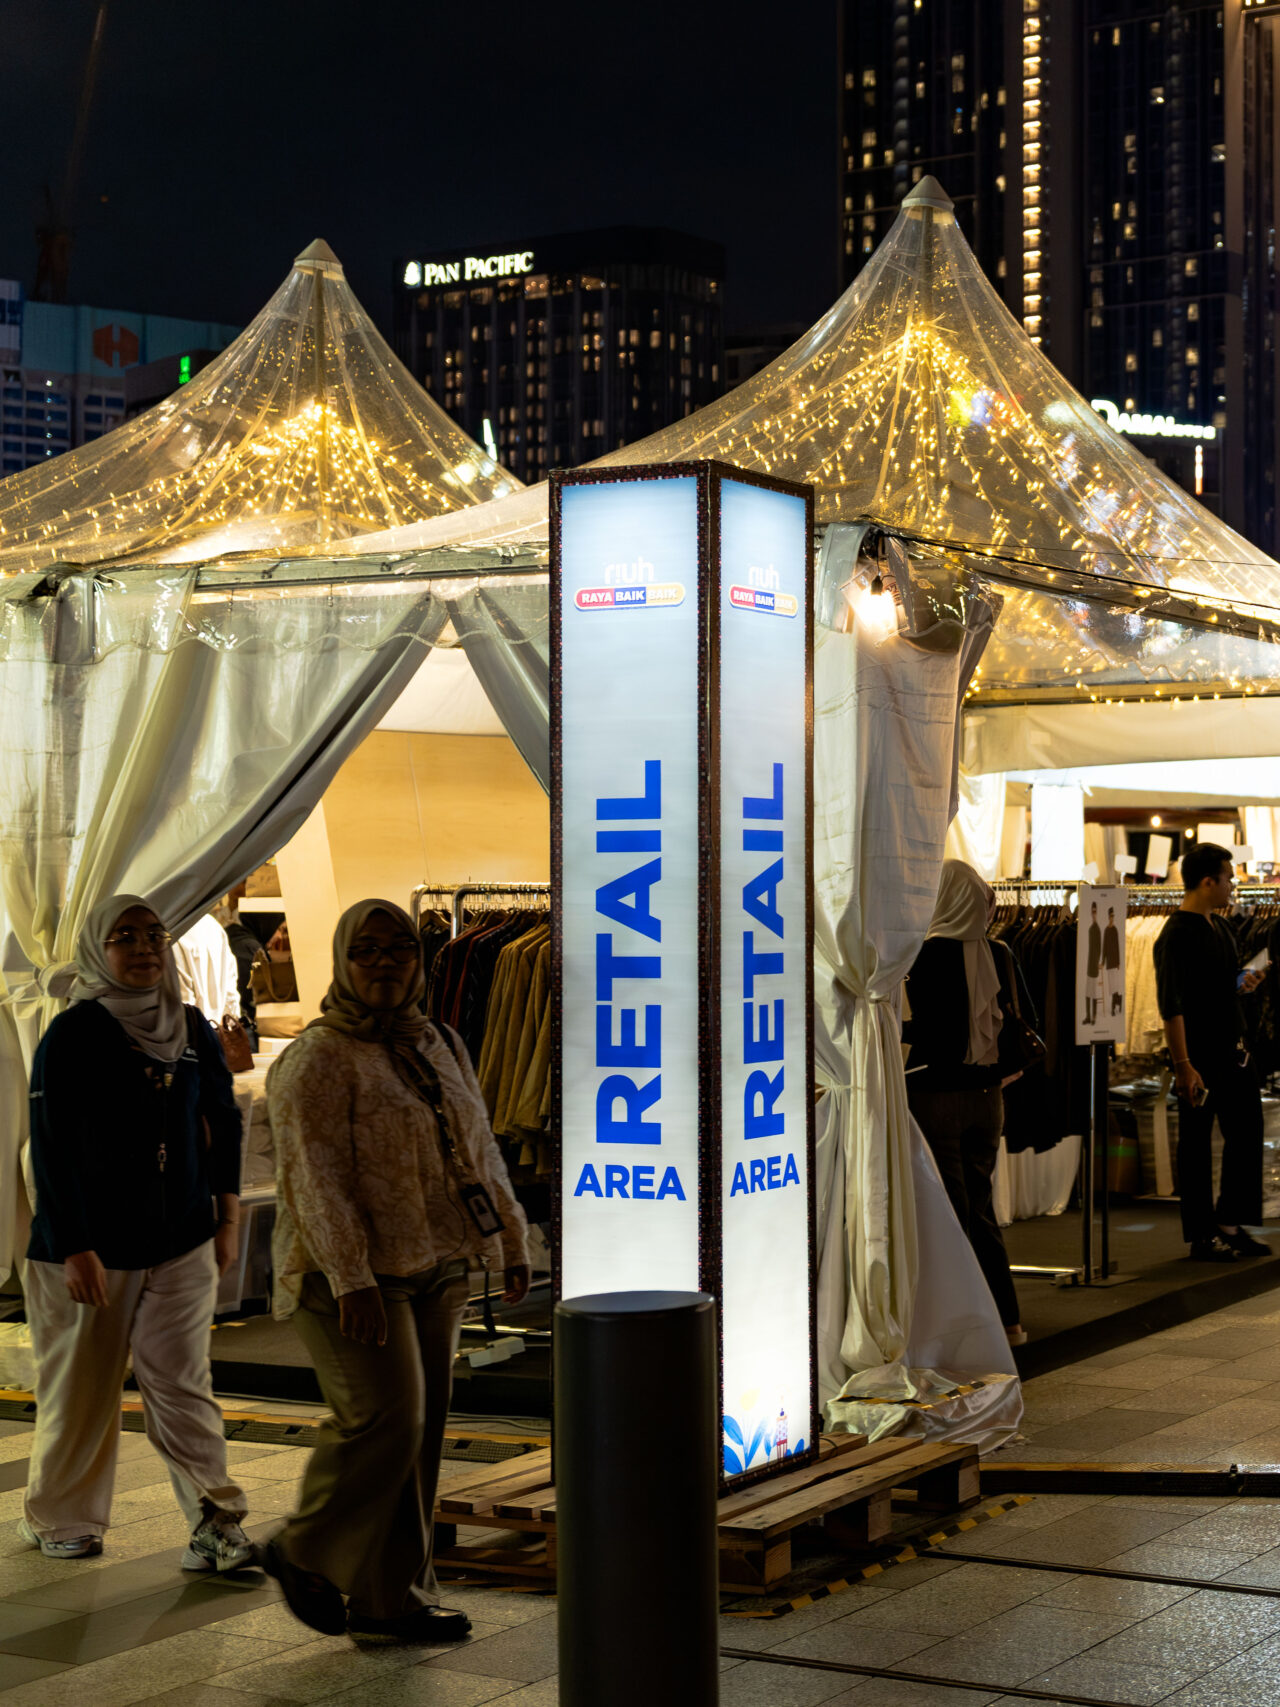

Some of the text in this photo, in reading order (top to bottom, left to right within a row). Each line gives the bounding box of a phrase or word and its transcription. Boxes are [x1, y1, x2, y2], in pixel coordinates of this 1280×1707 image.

[424, 251, 535, 286] PAN PACIFIC
[581, 588, 678, 604] RAYA BAIK BAIK
[733, 590, 754, 603] RAYA
[755, 594, 775, 607] BAIK
[596, 760, 661, 1145] RETAIL
[743, 763, 784, 1140] RETAIL
[574, 1163, 686, 1201] AREA
[730, 1153, 800, 1197] AREA
